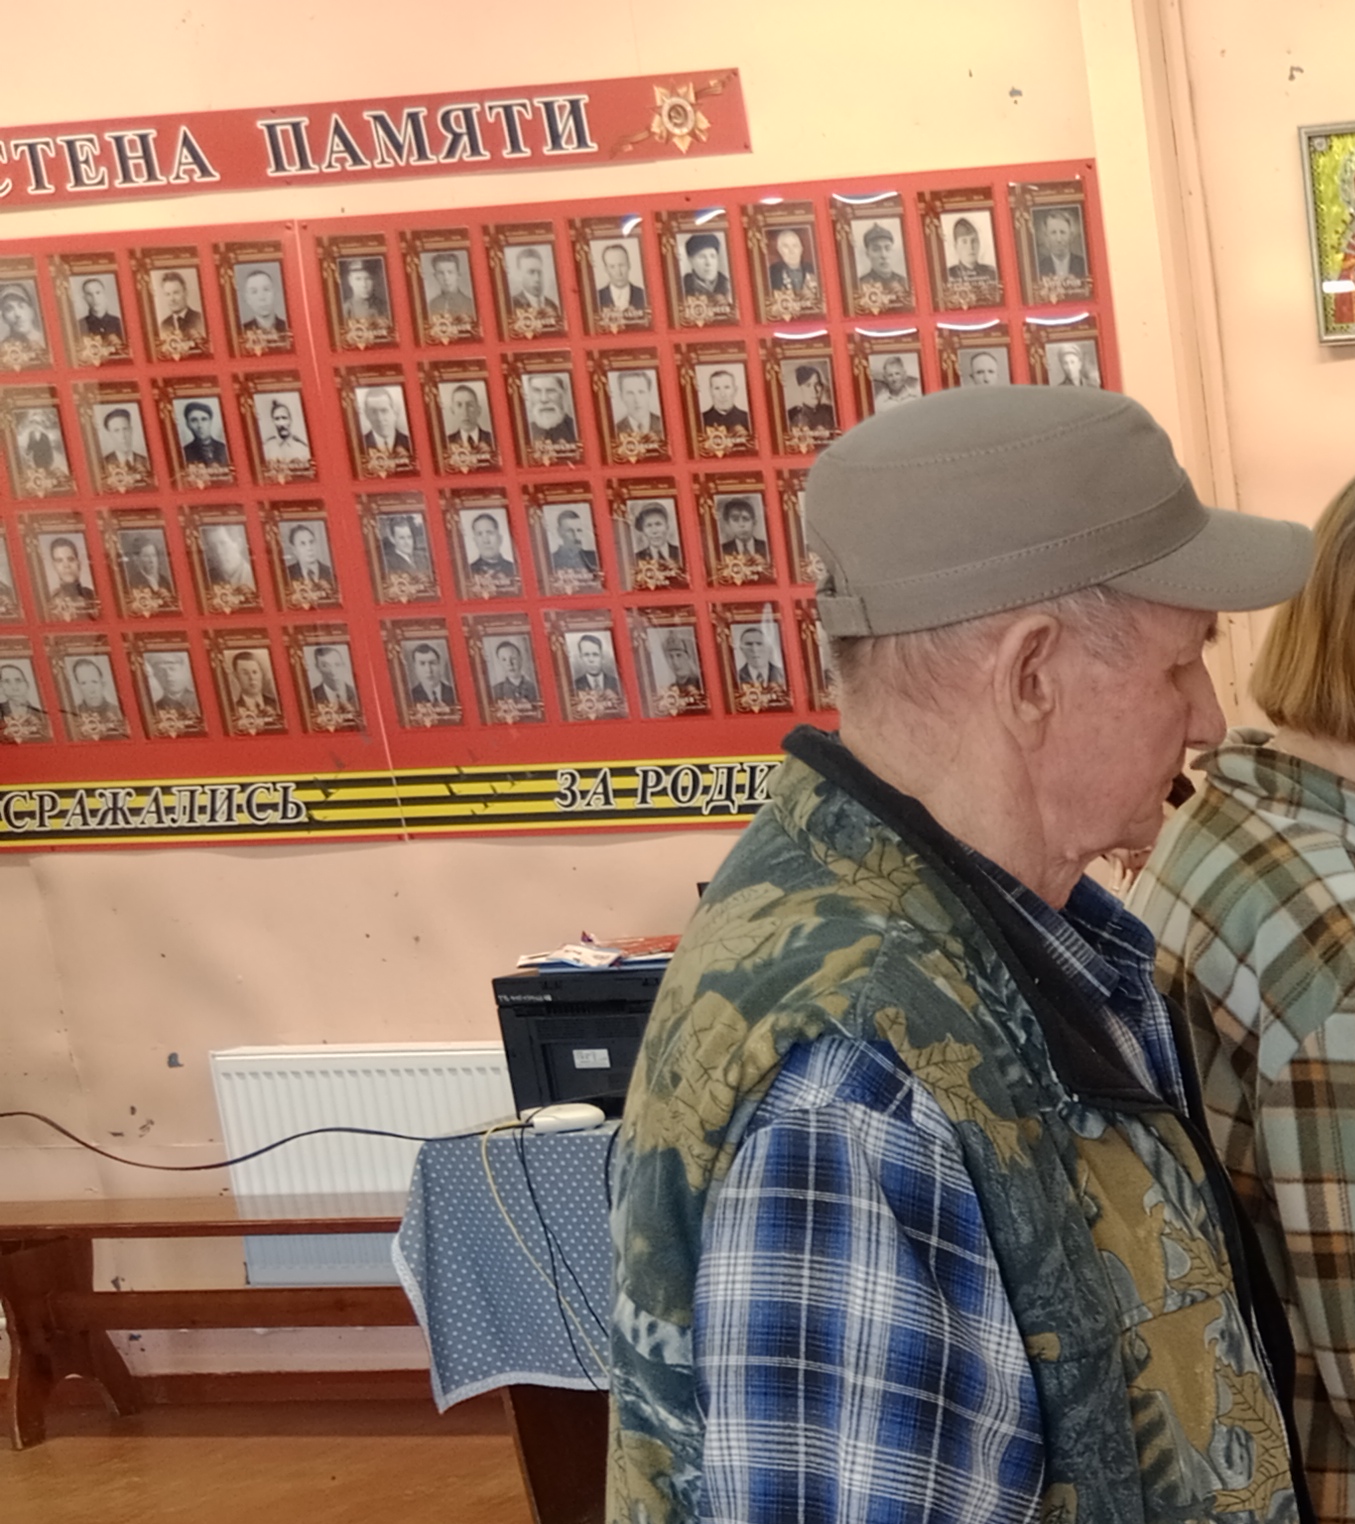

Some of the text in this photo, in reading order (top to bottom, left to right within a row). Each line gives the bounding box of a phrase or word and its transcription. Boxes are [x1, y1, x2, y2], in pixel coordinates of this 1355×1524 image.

[258, 93, 600, 178] ПАМЯТИ
[0, 782, 309, 832] СРАЖАЛИСЬ
[554, 767, 616, 811] ЗА
